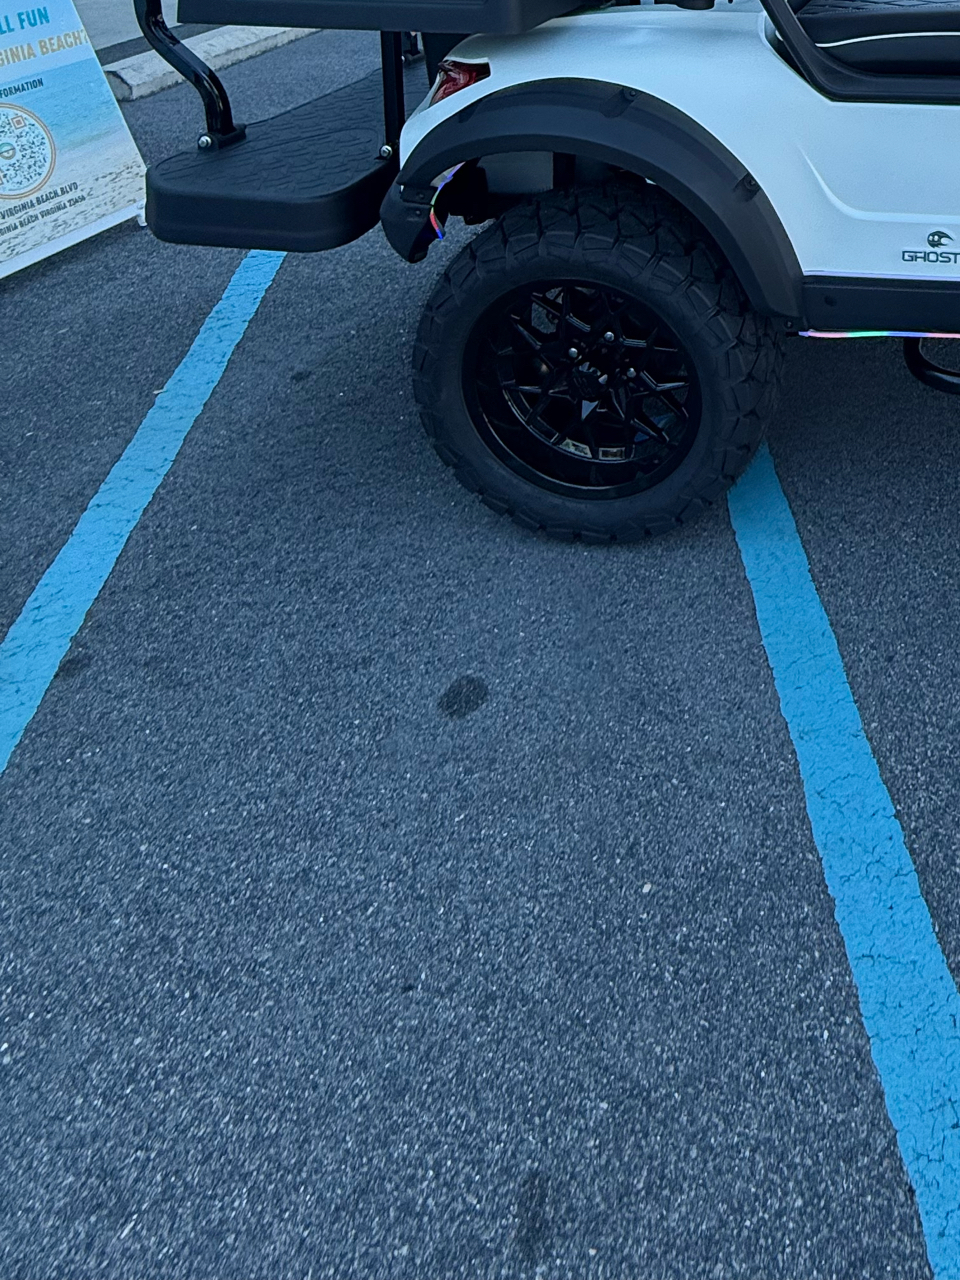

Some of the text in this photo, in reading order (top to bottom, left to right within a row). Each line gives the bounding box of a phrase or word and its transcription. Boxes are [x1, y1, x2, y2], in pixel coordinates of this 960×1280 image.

[17, 6, 50, 30] FUN
[0, 182, 78, 219] VIRGINIA BEACH BLVD
[19, 214, 39, 227] BEACH
[39, 202, 67, 218] VIRGINIA
[902, 250, 960, 264] GHOST
